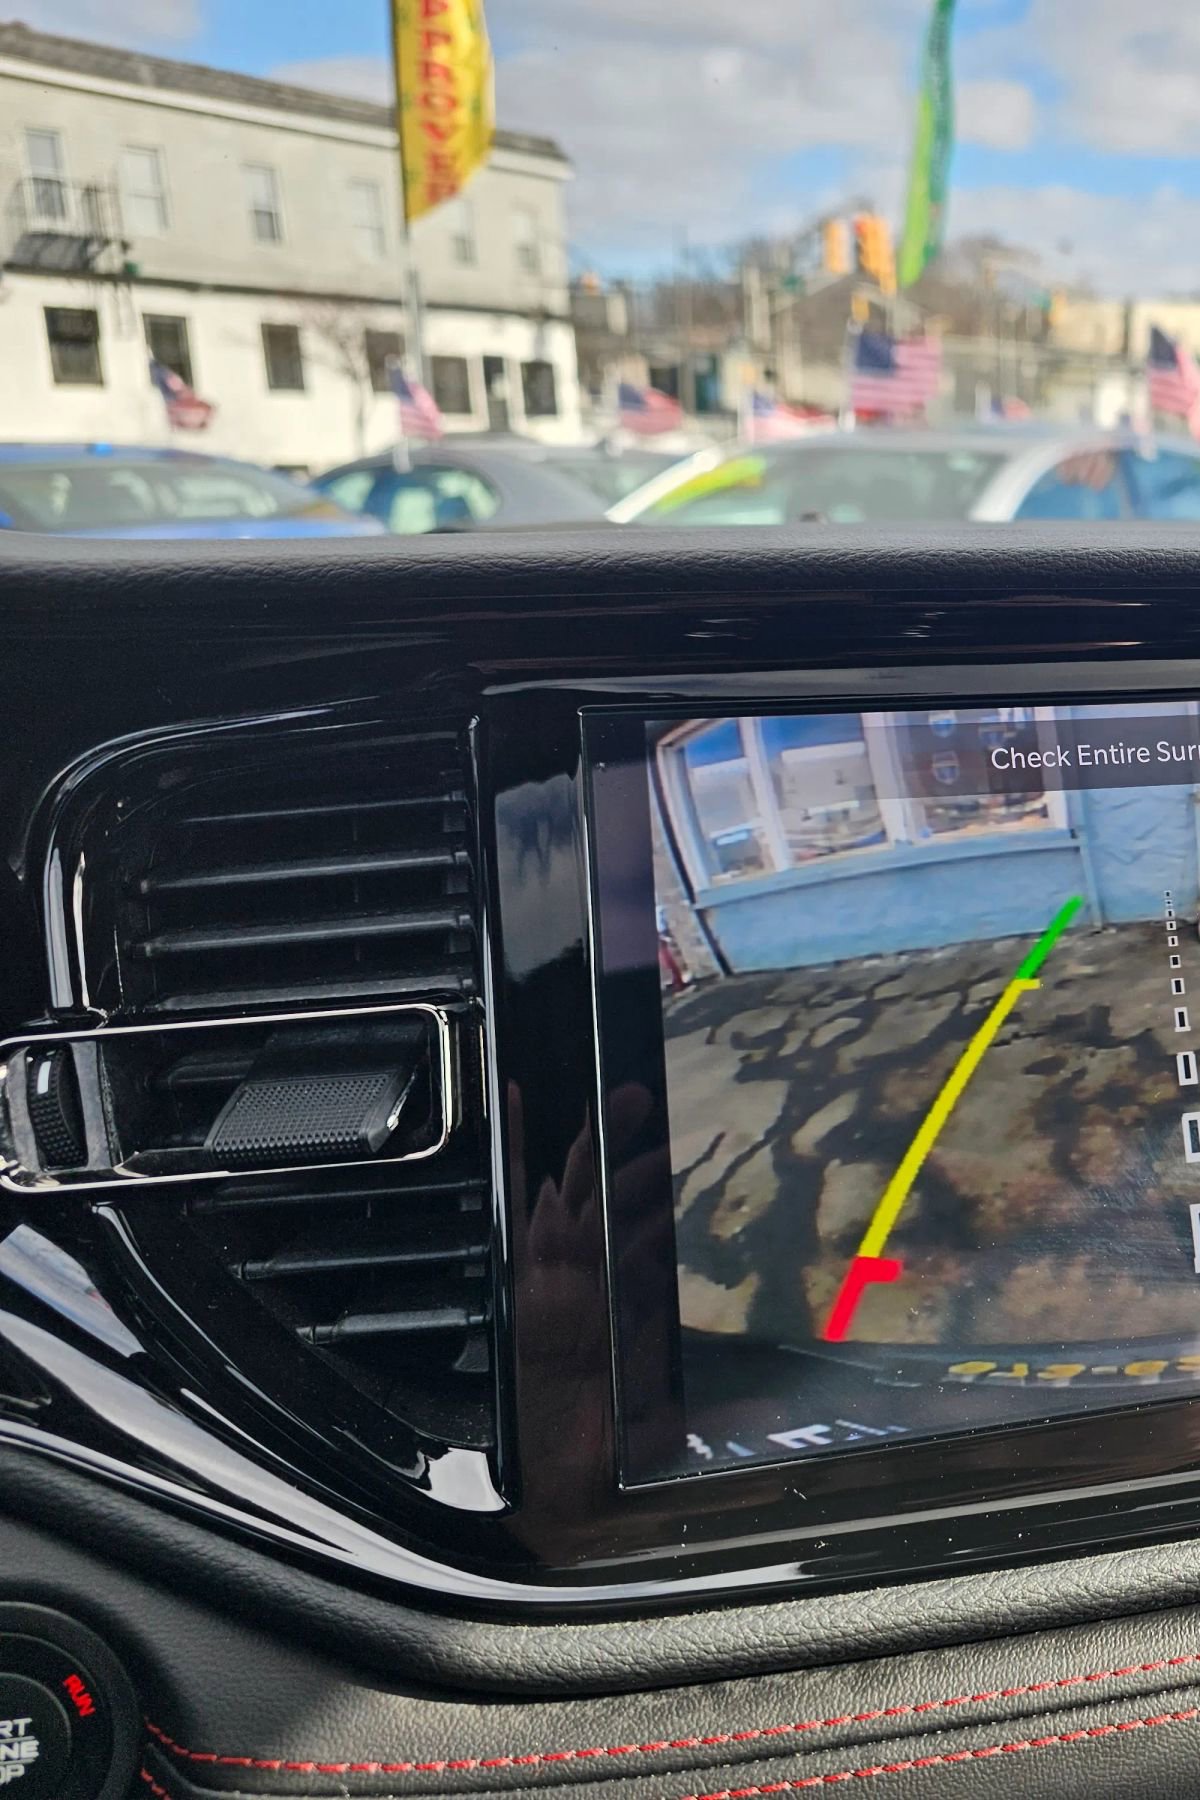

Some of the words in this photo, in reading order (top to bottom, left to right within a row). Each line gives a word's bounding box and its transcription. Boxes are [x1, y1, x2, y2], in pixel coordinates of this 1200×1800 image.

[991, 746, 1071, 770] Check
[1077, 742, 1151, 766] Entire
[63, 1674, 97, 1717] RUN
